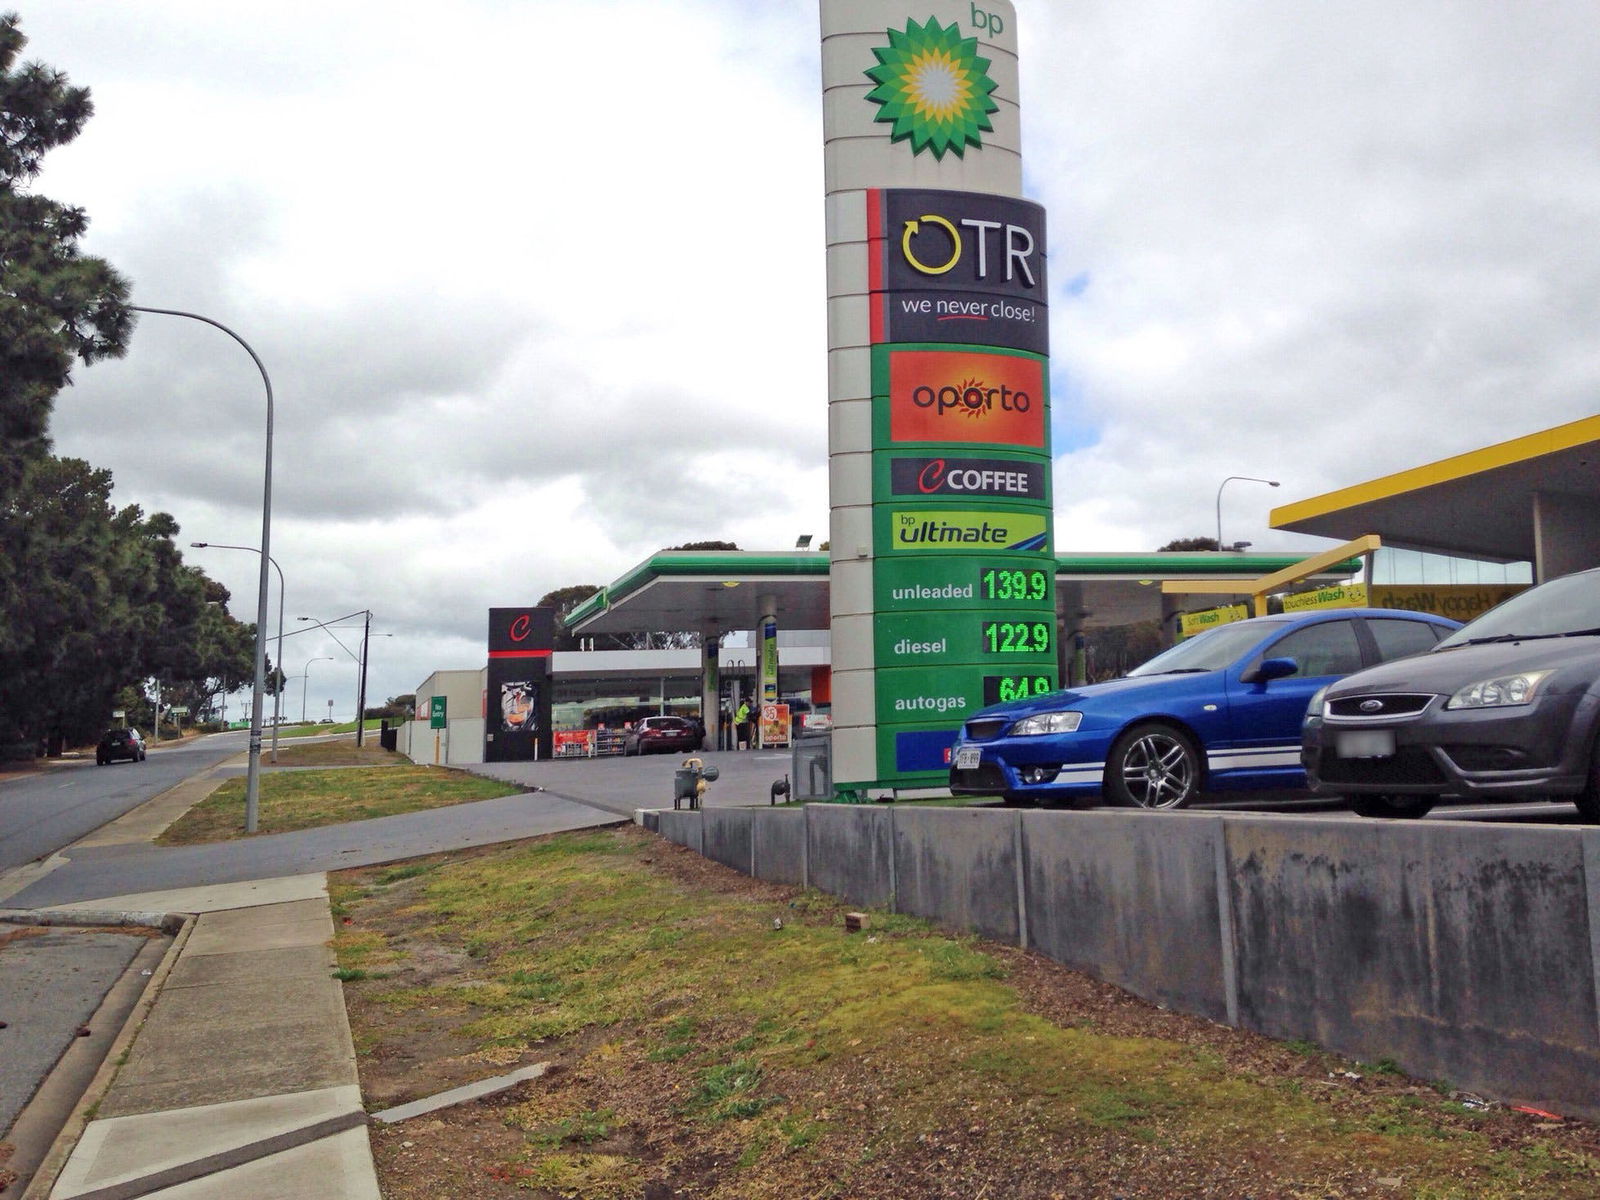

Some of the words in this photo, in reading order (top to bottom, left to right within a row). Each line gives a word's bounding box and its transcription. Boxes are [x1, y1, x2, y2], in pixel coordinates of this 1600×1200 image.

[970, 2, 1004, 38] bp
[902, 214, 1036, 286] OTR
[902, 300, 932, 313] we
[937, 300, 989, 316] never
[991, 300, 1036, 323] close!
[913, 384, 1030, 416] oporto
[947, 469, 1028, 493] COFFEE
[900, 521, 1008, 543] ultimate
[901, 514, 916, 526] bp
[892, 583, 973, 600] unleaded
[983, 570, 1046, 600] 139.9
[894, 638, 947, 654] diesel
[985, 623, 1049, 652] 122.9
[895, 696, 967, 713] autogas
